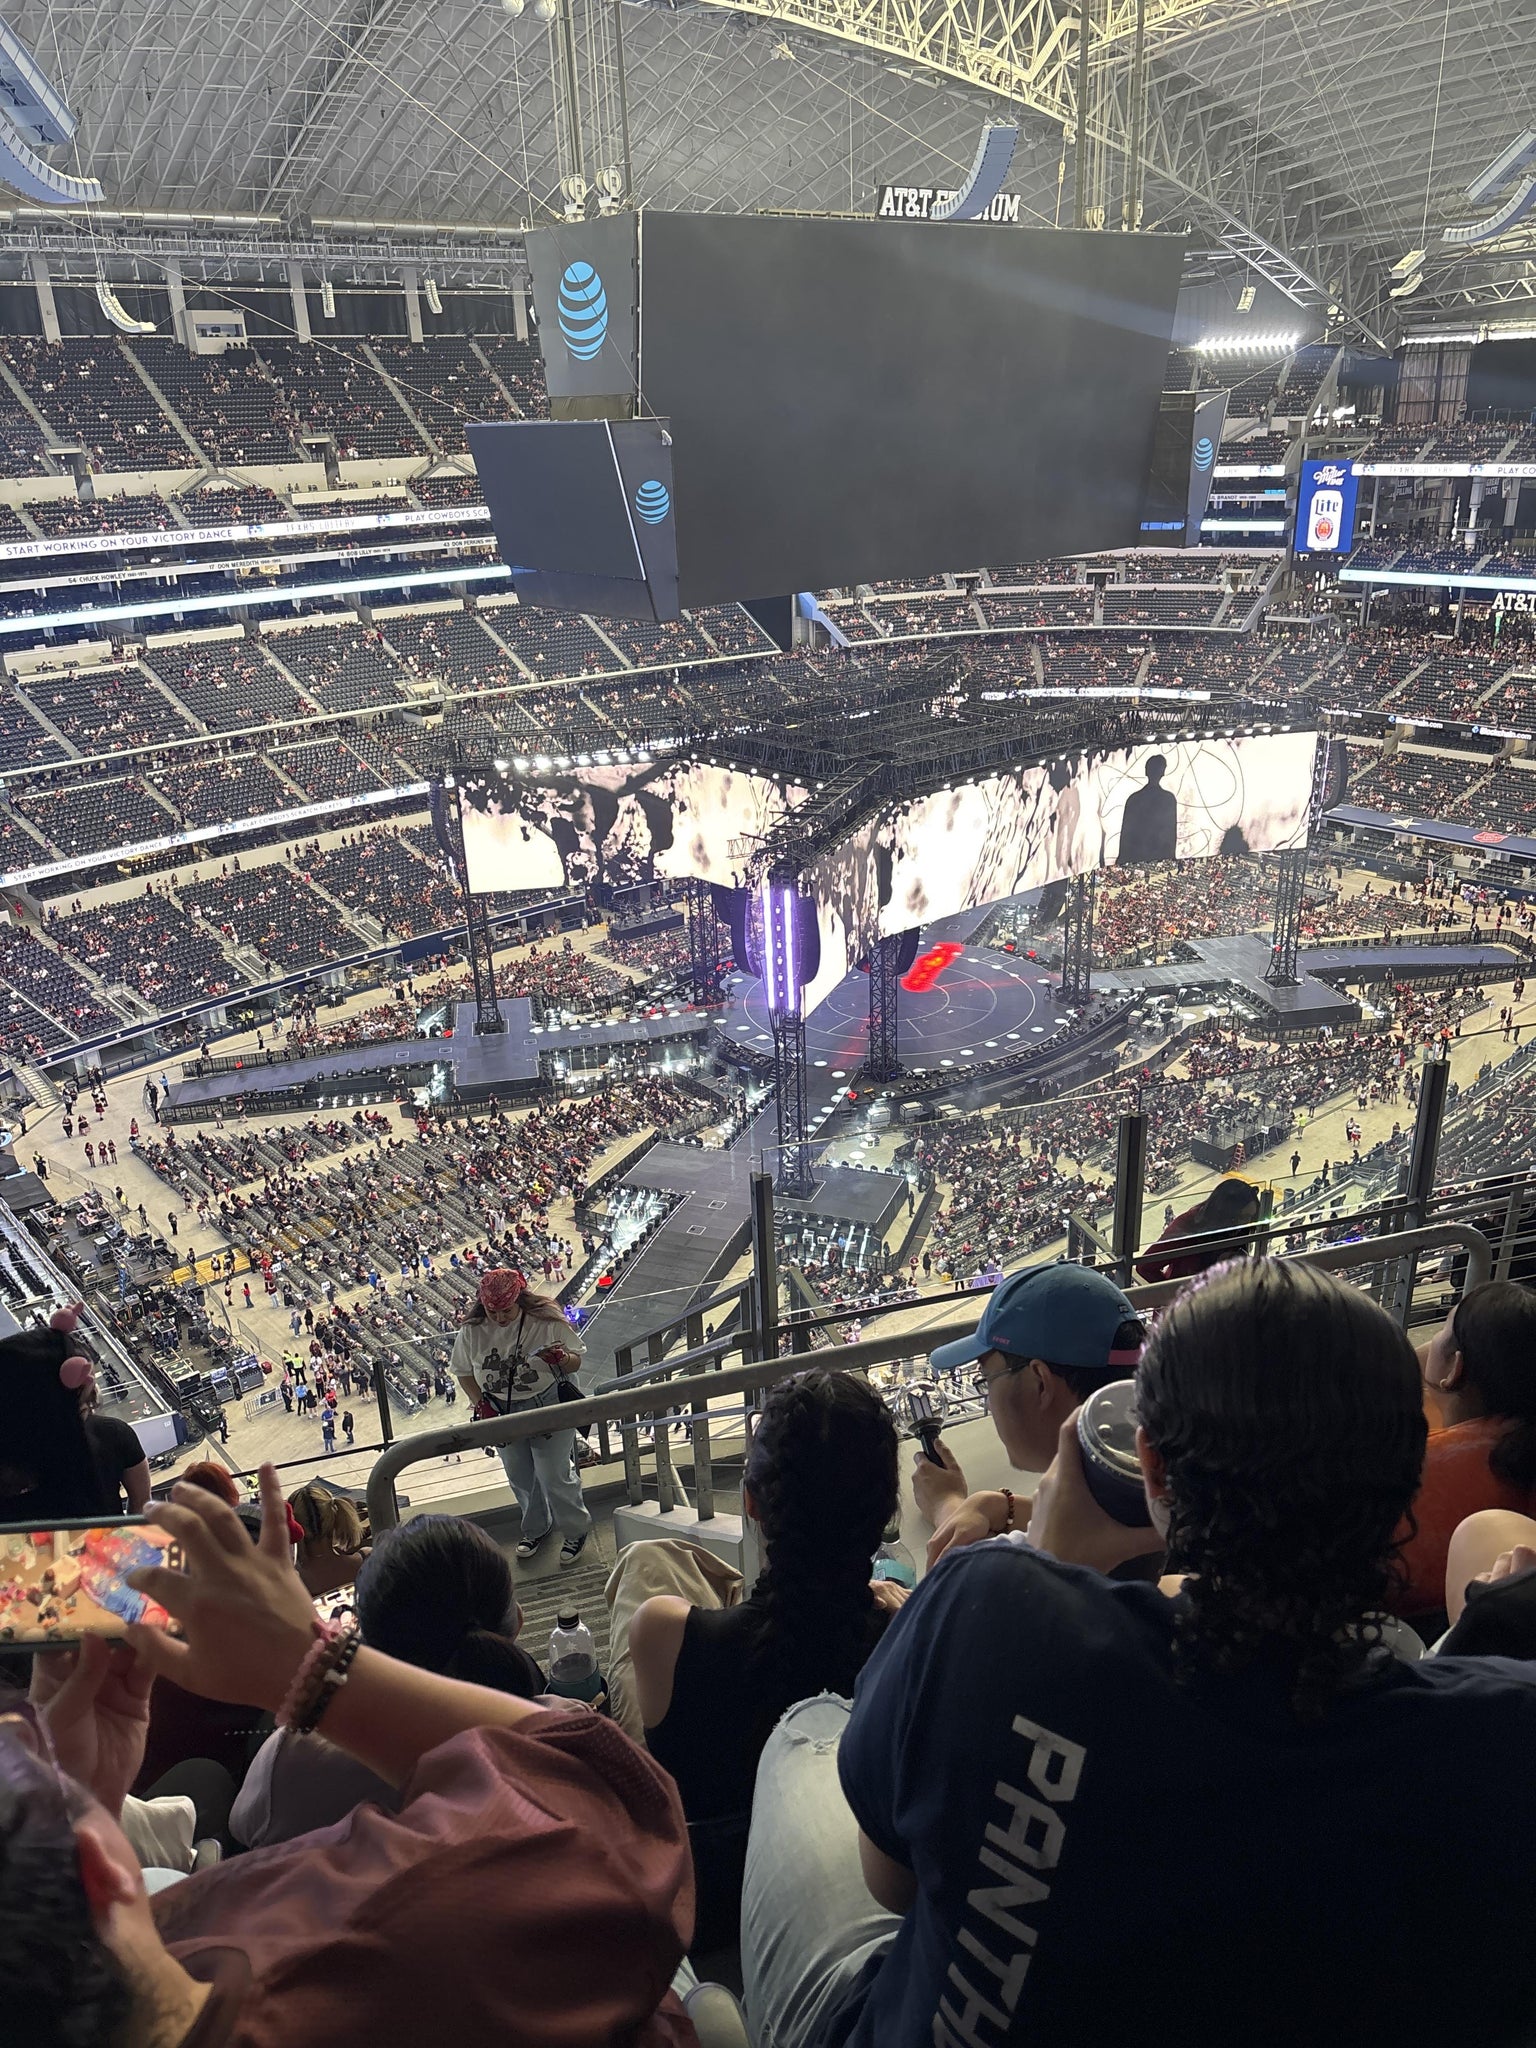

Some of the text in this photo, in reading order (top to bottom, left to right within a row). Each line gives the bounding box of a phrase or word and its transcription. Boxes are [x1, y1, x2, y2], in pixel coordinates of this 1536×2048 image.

[879, 187, 933, 218] AT&T
[405, 514, 427, 523] PLAY
[428, 510, 471, 520] COWBOYS
[1315, 499, 1339, 516] Lite
[6, 529, 233, 556] START WORKING ON YOUR VICTORY DANCE
[231, 559, 259, 568] MEREDITH
[101, 572, 126, 581] HOWLEY
[1491, 592, 1536, 612] AT&T
[1395, 716, 1444, 729] Blockchain.com
[1479, 727, 1532, 740] Blockchain.com
[242, 819, 258, 828] PLAY
[258, 813, 290, 825] COWBOYS
[290, 806, 318, 818] SCRATCH
[13, 841, 163, 882] START WORKING ON YOUR VICTORY DANCE
[932, 1714, 1087, 2048] PANTH
